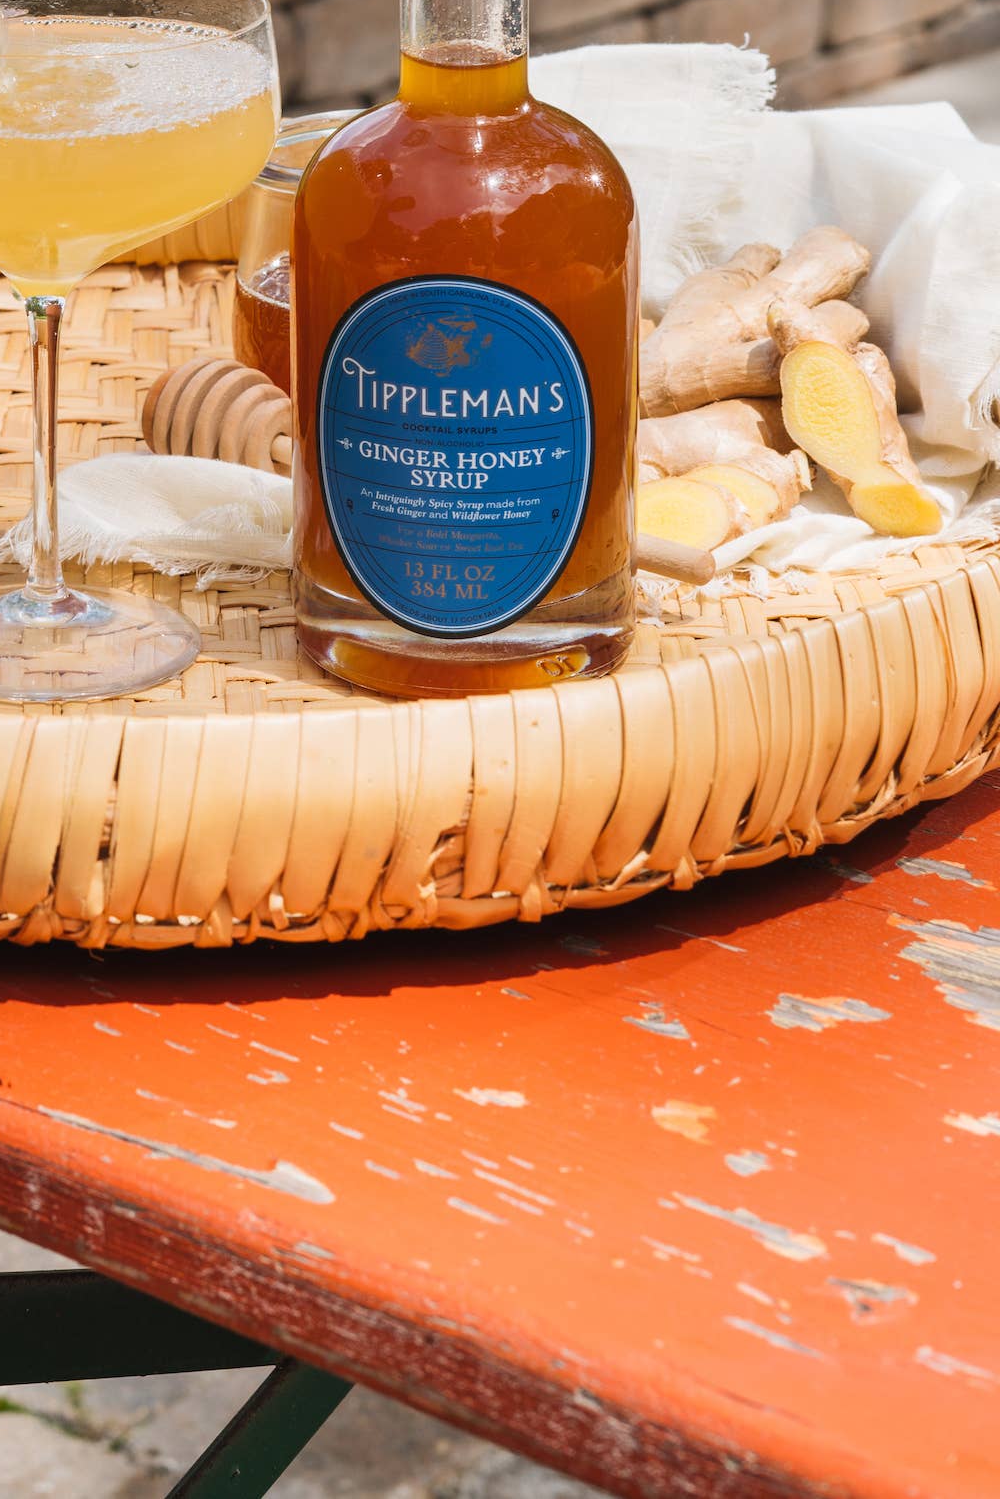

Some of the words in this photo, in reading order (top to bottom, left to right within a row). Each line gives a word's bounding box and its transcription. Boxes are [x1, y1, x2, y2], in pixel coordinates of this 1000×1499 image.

[420, 289, 447, 299] SOUTH
[342, 357, 564, 418] TIPPLEMAN'S
[402, 423, 455, 435] COCKTAIL
[457, 426, 498, 435] SYRUPS
[359, 440, 450, 469] GINGER
[457, 447, 546, 470] HONEY
[410, 469, 489, 489] SYRUP
[360, 487, 374, 499] An
[375, 490, 427, 508] Intriguingly
[428, 498, 454, 510] Spicy
[457, 500, 484, 511] Syrup
[486, 498, 515, 509] made
[516, 496, 541, 507] from
[371, 501, 395, 514] Fresh
[396, 505, 427, 519] Ginger
[428, 509, 448, 520] and
[451, 510, 501, 522] Wildflower
[503, 509, 532, 521] Honey
[425, 528, 448, 539] Bold
[404, 561, 425, 578] 13
[432, 564, 458, 580] FL
[464, 565, 495, 581] OZ
[411, 580, 447, 598] 384
[455, 583, 489, 599] ML
[421, 612, 448, 623] ABOUT
